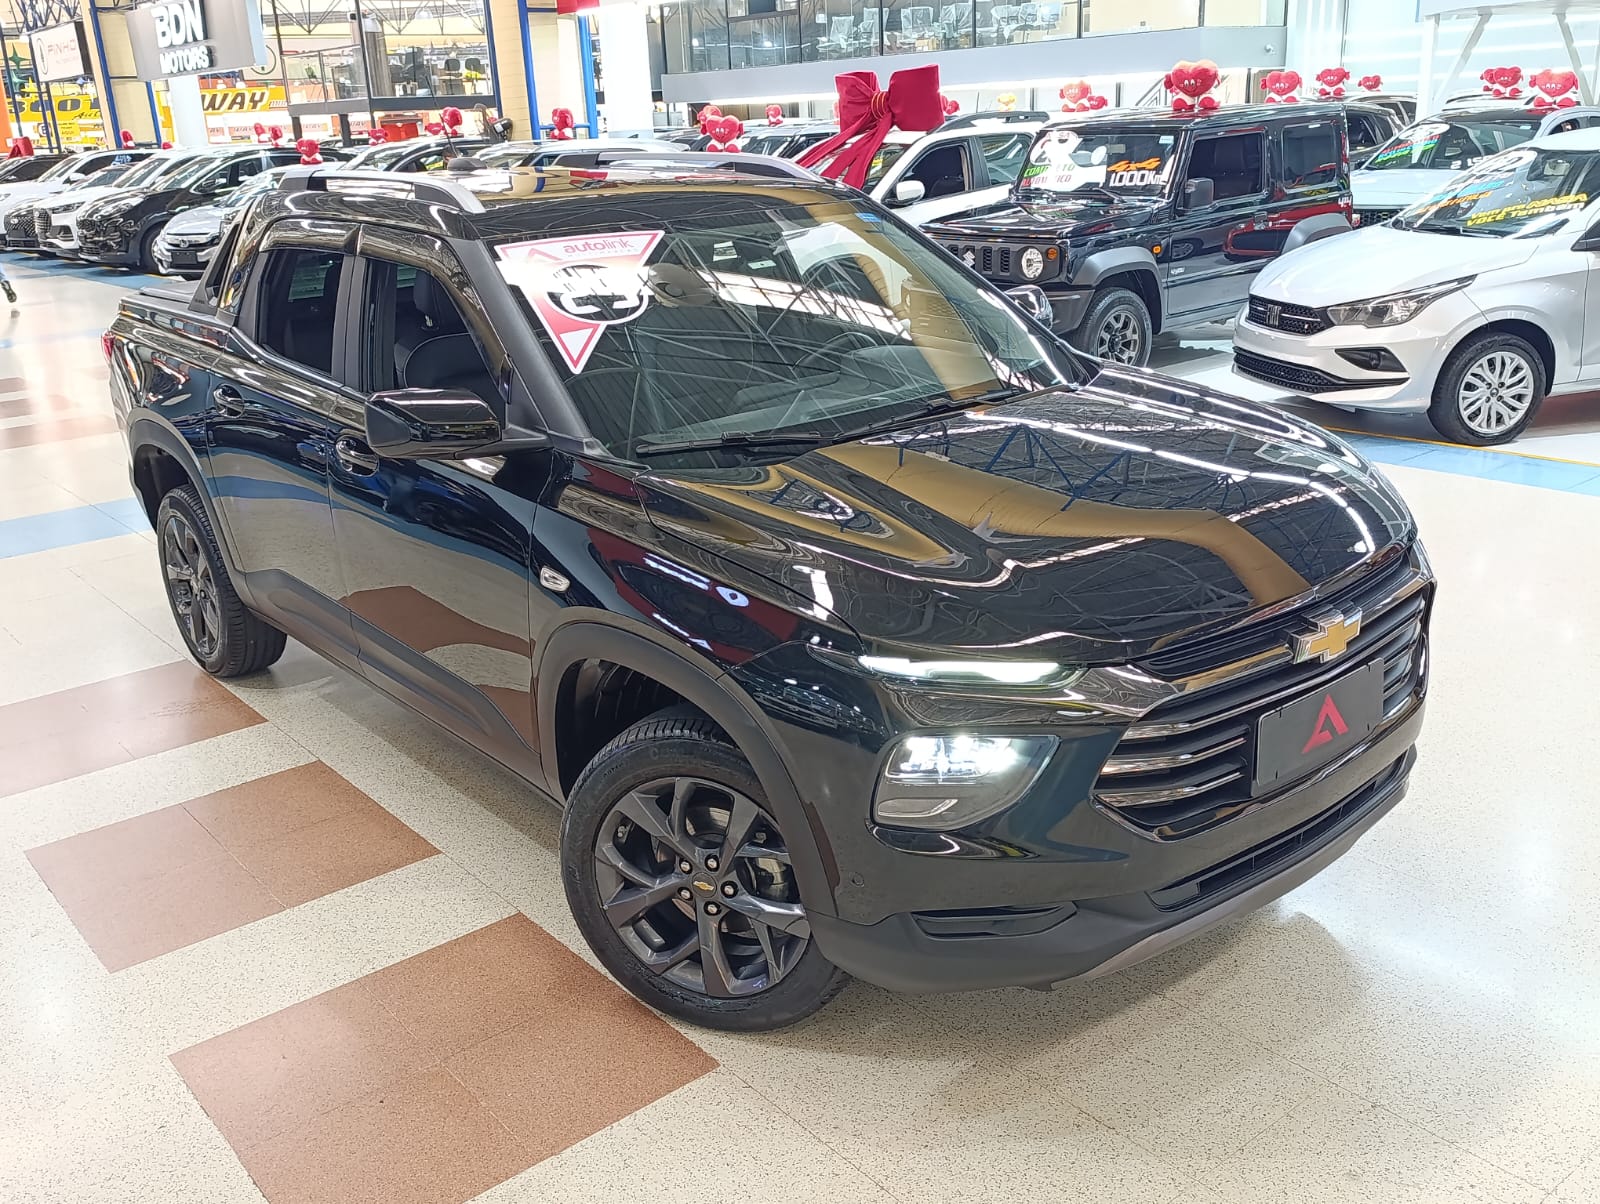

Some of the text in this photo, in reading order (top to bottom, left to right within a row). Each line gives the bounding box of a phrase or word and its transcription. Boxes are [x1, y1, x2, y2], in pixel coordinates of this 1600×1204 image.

[151, 0, 204, 48] BDN
[160, 45, 210, 74] MOTORS
[564, 239, 634, 253] autolink
